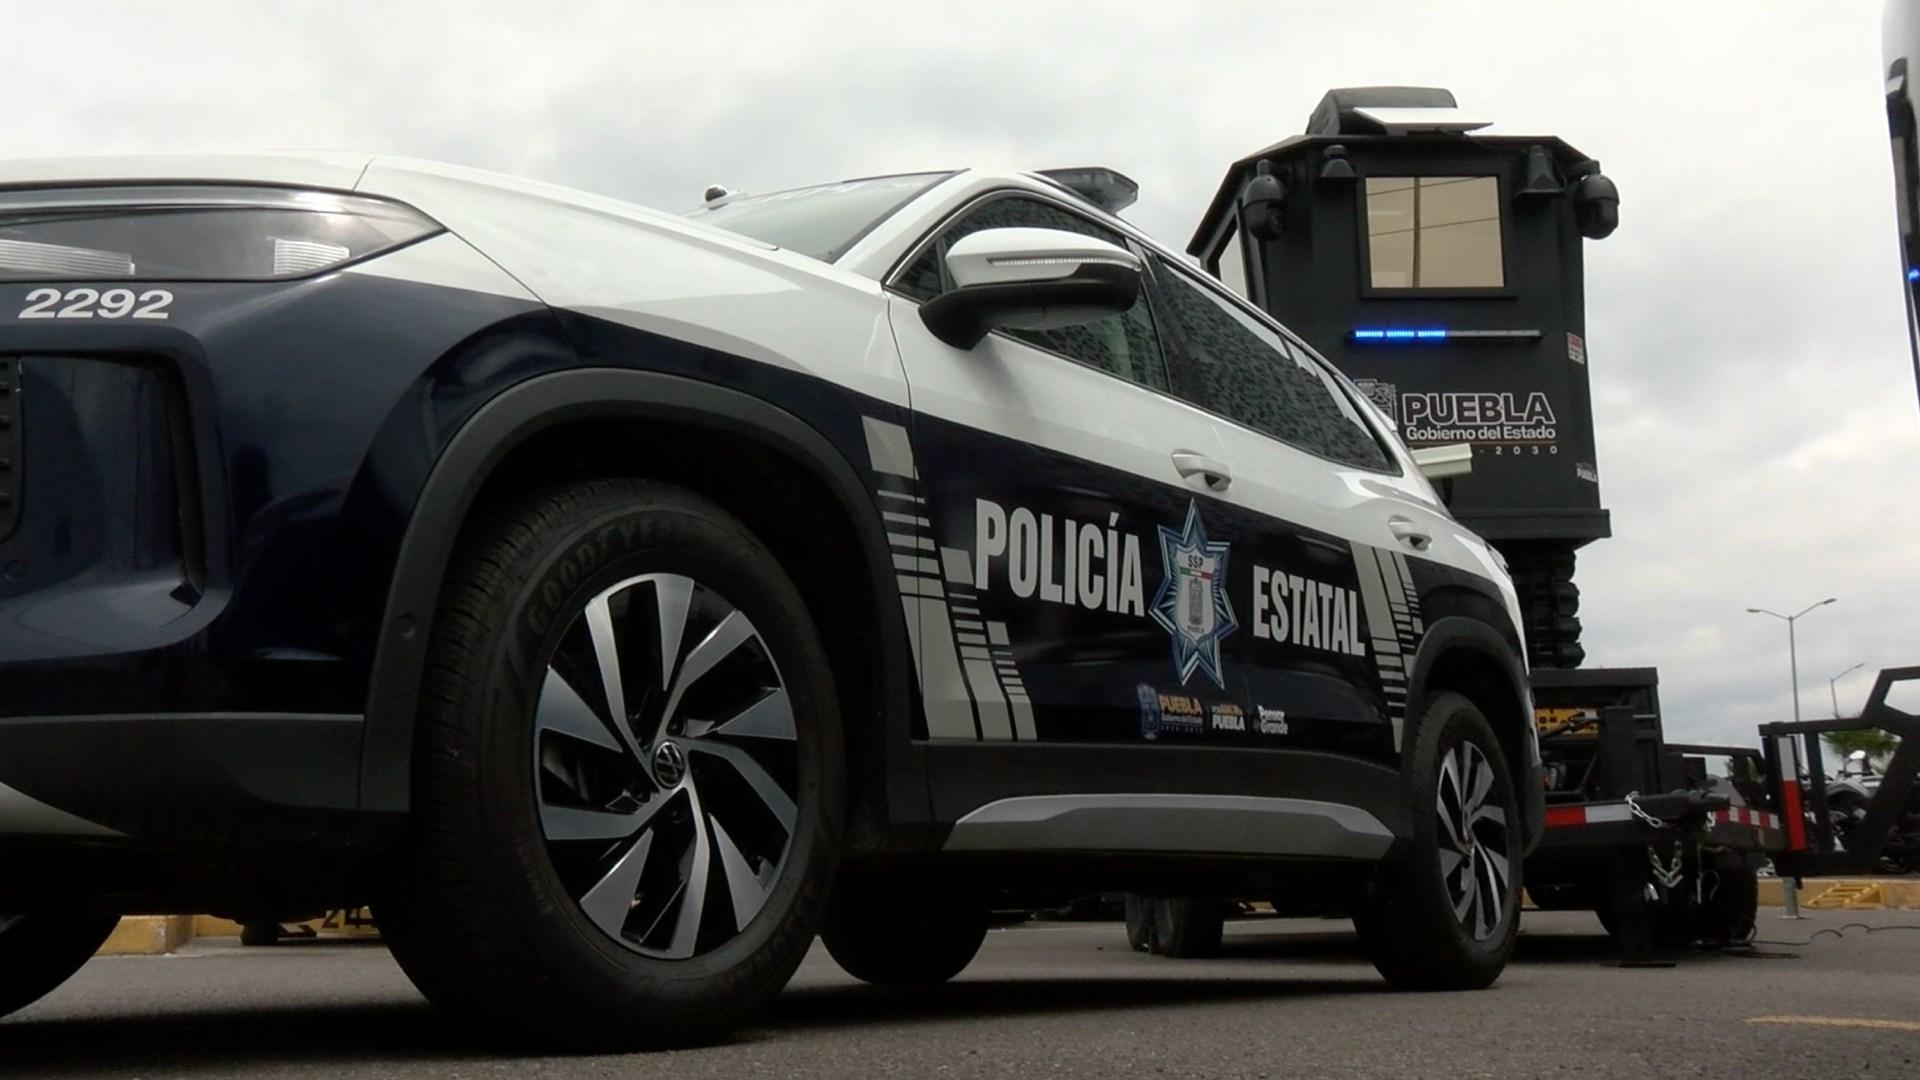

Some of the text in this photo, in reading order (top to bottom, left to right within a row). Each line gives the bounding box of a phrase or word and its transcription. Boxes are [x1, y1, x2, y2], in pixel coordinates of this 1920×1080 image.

[18, 288, 174, 319] 2292
[1402, 392, 1556, 426] PUEBLA
[1406, 425, 1556, 440] Gobierno del Estado
[1187, 554, 1204, 569] SSP
[975, 498, 1366, 657] POLICÍA ESTATAL
[1158, 694, 1203, 715] PUEBLA
[1212, 713, 1246, 731] PUEBLA
